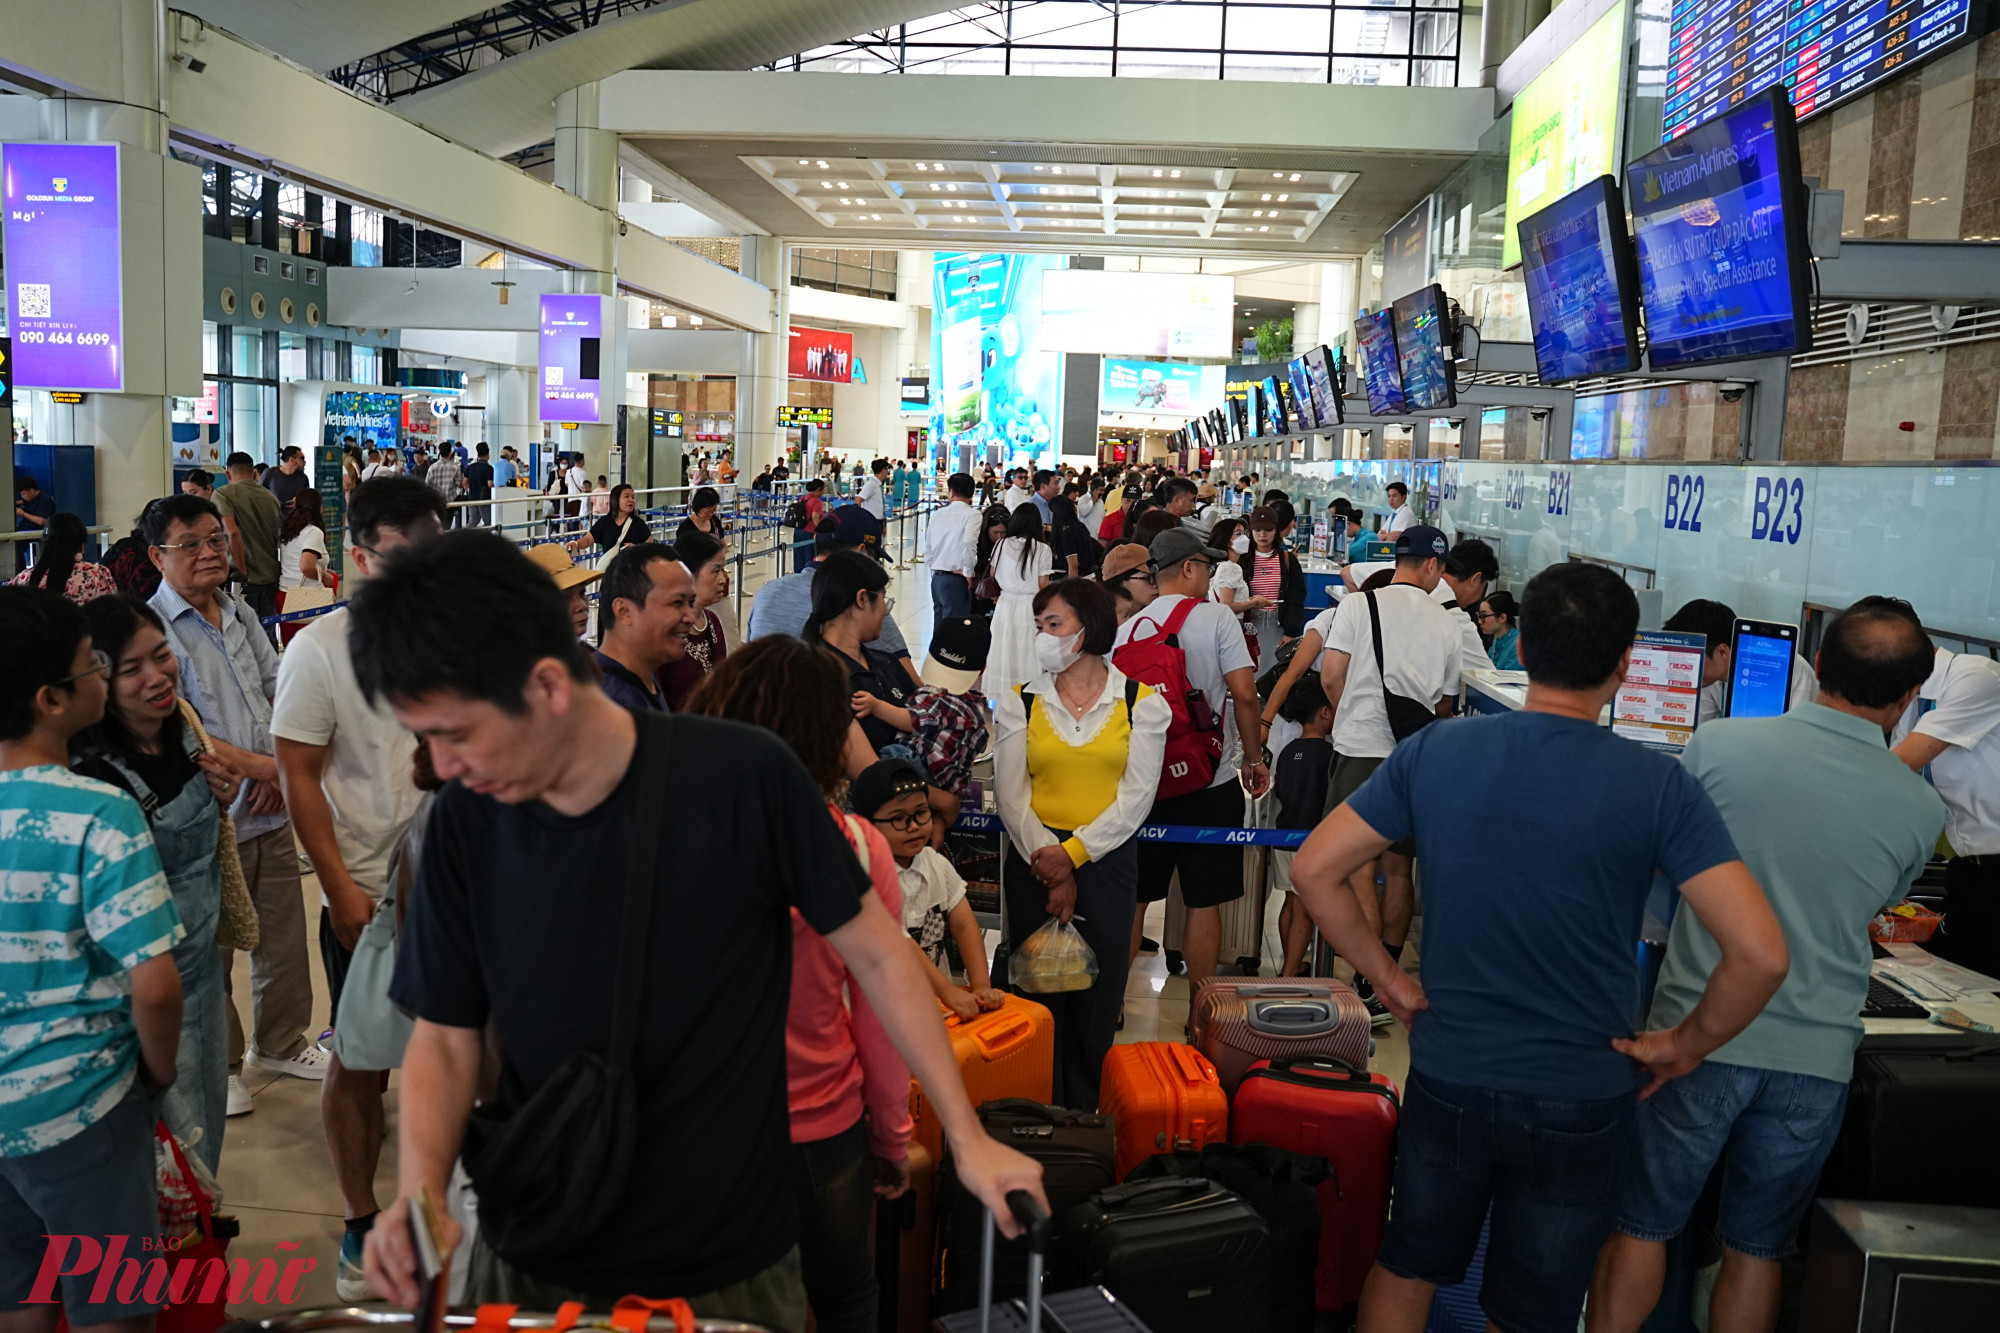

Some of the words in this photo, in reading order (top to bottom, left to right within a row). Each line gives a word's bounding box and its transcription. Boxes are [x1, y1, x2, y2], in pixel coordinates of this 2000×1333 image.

[1920, 15, 1934, 29] Now
[1933, 0, 1959, 22] Check-in
[1917, 37, 1931, 51] Now
[1930, 22, 1956, 43] Check-in
[26, 194, 54, 202] GOLDSUN
[73, 195, 95, 203] GROUP
[1703, 265, 1731, 297] Special
[1732, 257, 1777, 286] Assistance
[19, 331, 45, 344] 090
[48, 331, 73, 345] 464
[76, 332, 110, 346] 6699
[851, 357, 867, 384] A
[545, 391, 559, 399] 090
[560, 391, 575, 399] 464
[576, 392, 595, 400] 6699
[325, 410, 356, 426] Vietnam
[354, 412, 383, 428] Airlines
[1505, 469, 1525, 510] B20
[1547, 471, 1571, 516] B21
[1664, 474, 1705, 533] B22
[1751, 476, 1804, 545] B23
[960, 816, 990, 828] ACV
[1137, 827, 1167, 839] ACV
[1225, 831, 1256, 842] ACV
